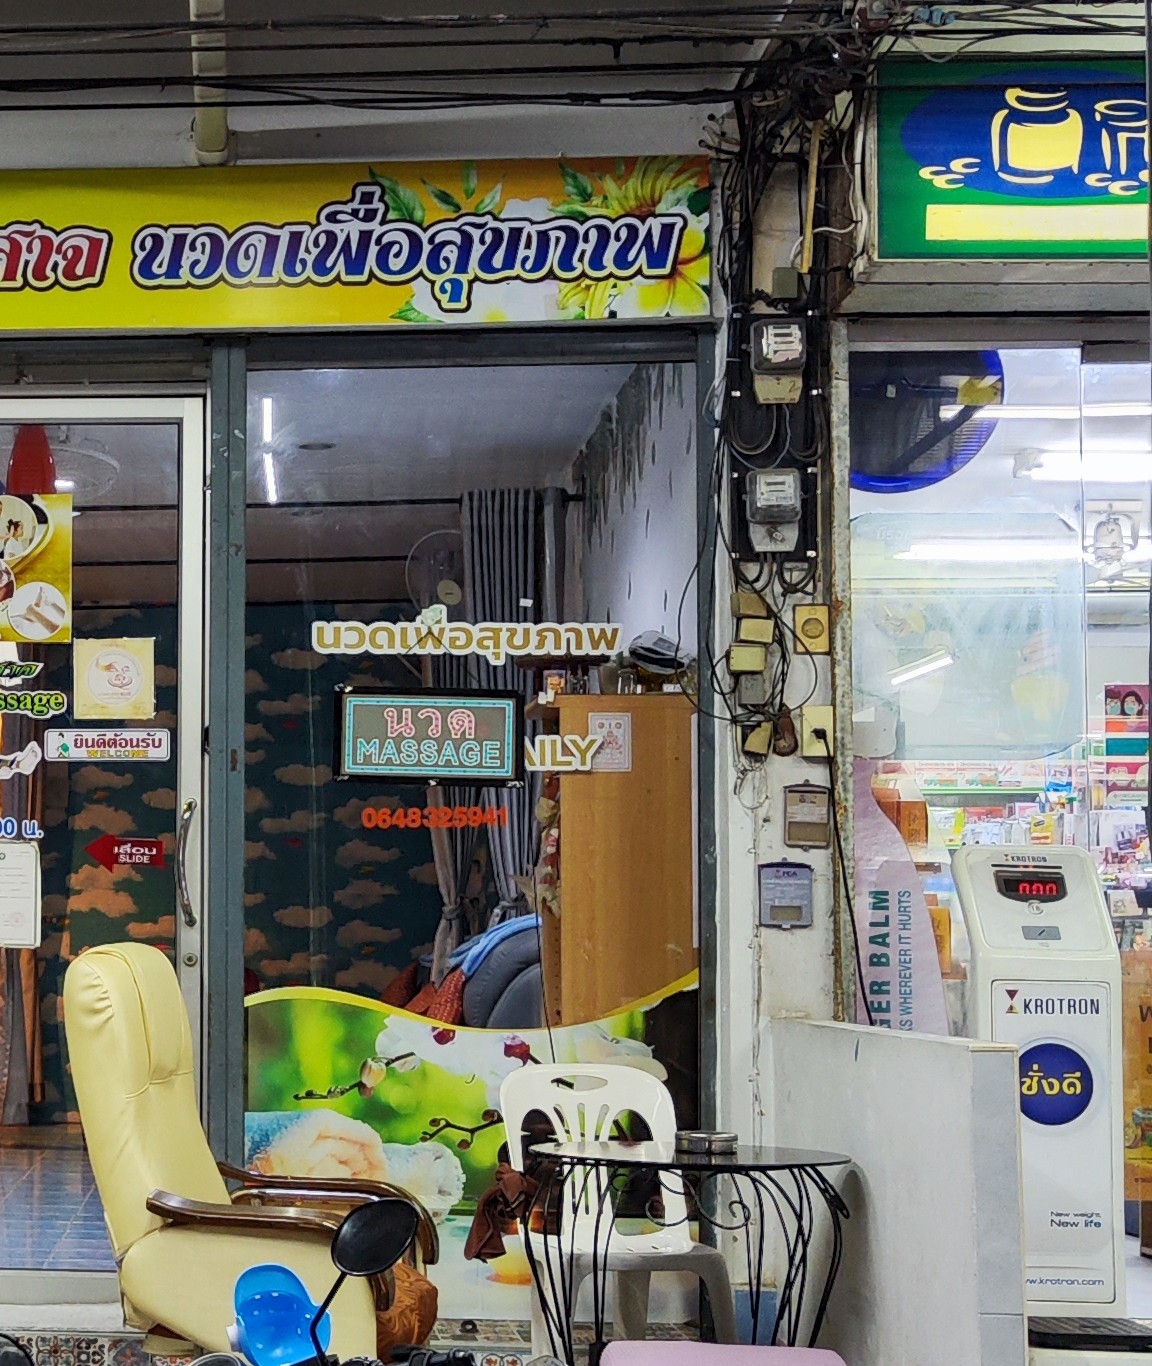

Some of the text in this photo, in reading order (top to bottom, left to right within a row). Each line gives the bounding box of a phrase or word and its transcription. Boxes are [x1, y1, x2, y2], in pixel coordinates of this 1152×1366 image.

[134, 183, 684, 309] นวดเพื่อสุขภาพ
[383, 707, 476, 739] นวด
[73, 732, 162, 749] ยินดีต้อนรับ
[356, 738, 501, 767] MASSAGE
[86, 749, 150, 758] WELCOME
[22, 819, 45, 838] น.
[118, 855, 150, 864] SLIDE
[898, 890, 913, 931] HURTS
[868, 890, 891, 967] BALM
[898, 934, 913, 945] IT
[899, 948, 914, 1016] WHEREVER
[1023, 998, 1100, 1014] KROTRON
[1020, 1063, 1082, 1095] ชั่งดี
[1050, 1219, 1102, 1228] New life
